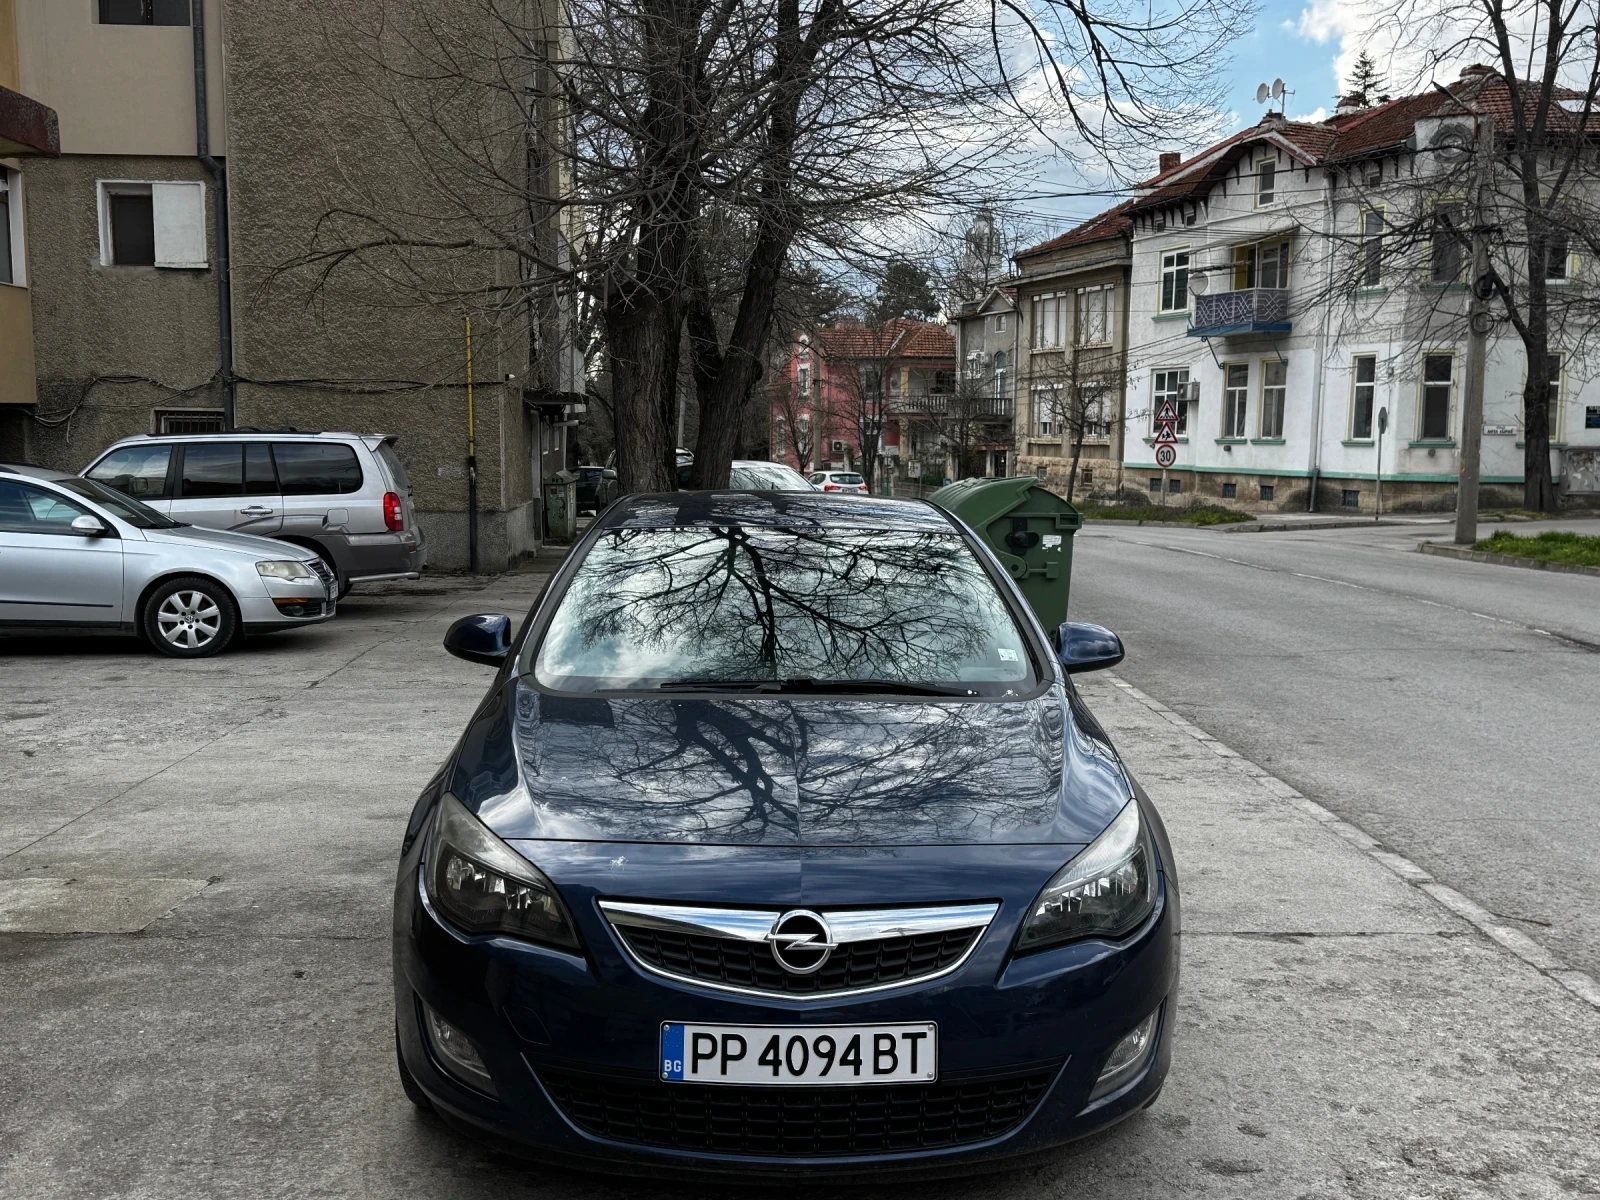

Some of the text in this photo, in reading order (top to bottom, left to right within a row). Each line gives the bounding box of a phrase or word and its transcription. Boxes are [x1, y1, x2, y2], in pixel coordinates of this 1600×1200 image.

[1160, 450, 1171, 462] 30
[691, 1032, 928, 1077] PP 4094 BT
[664, 1060, 682, 1072] BG
